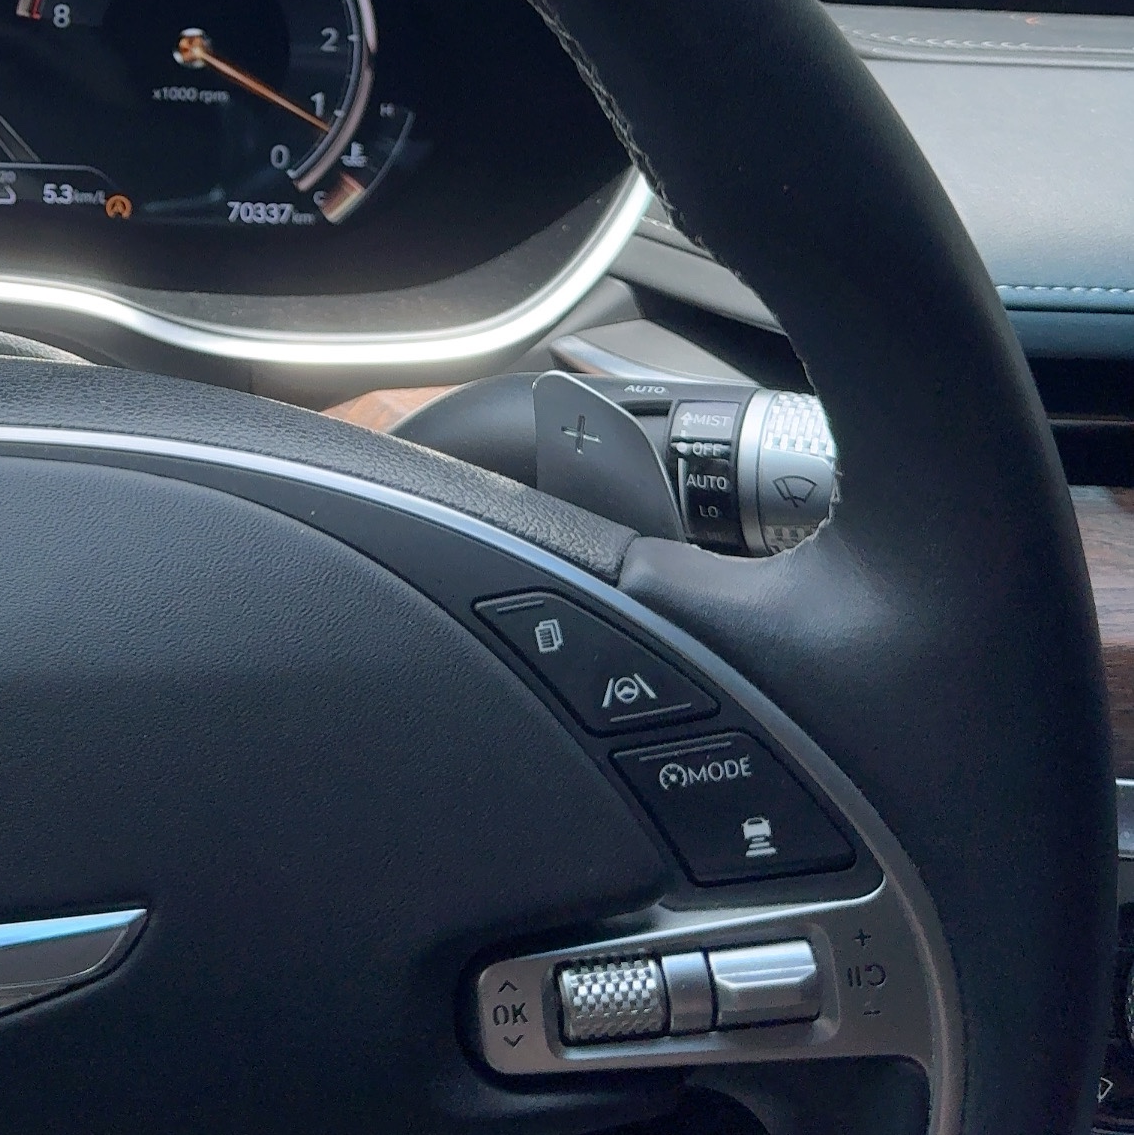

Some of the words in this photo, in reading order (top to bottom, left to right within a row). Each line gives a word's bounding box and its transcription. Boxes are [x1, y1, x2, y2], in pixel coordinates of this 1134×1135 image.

[52, 4, 71, 28] 8
[320, 27, 340, 53] 2
[310, 92, 325, 117] 1
[270, 144, 290, 169] 0
[623, 383, 670, 395] AUTO
[692, 414, 733, 427] MIST
[691, 441, 722, 458] OFF
[685, 475, 728, 491] AUTO
[698, 504, 720, 519] LO
[687, 754, 753, 785] MODE
[492, 1002, 529, 1026] OK
